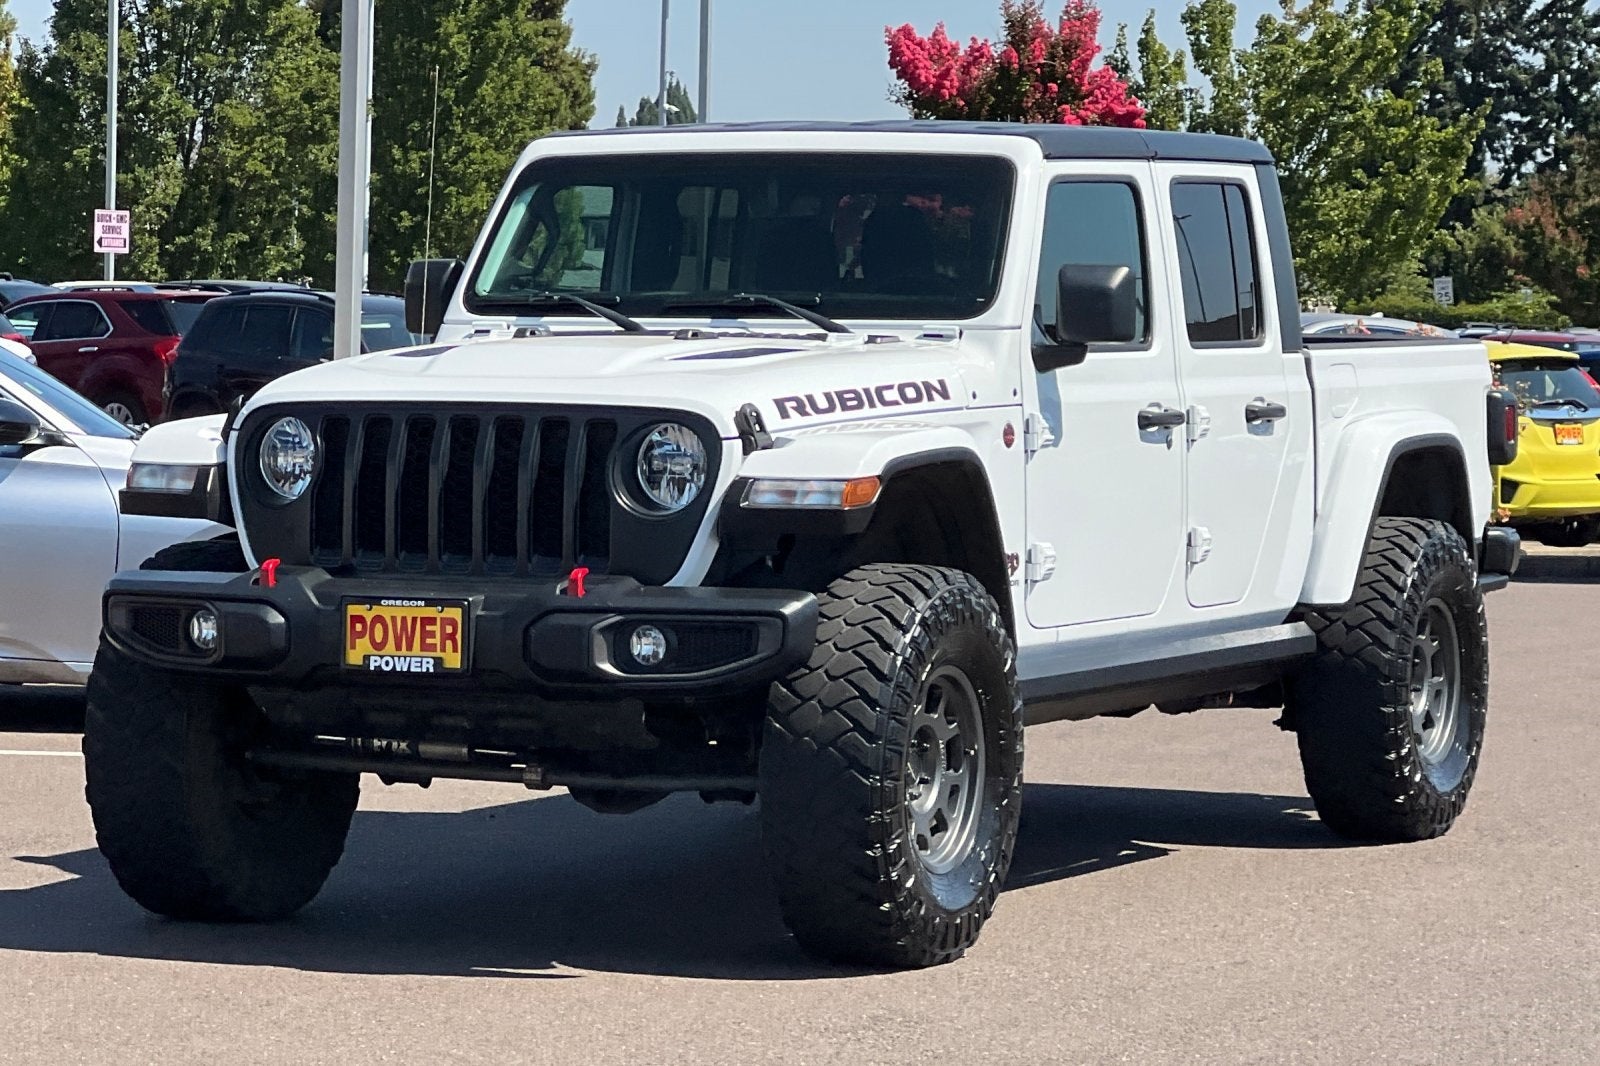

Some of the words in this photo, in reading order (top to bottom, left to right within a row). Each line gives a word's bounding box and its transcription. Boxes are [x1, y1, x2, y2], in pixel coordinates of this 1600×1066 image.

[97, 213, 112, 223] BUICK
[116, 214, 127, 223] GMC
[102, 225, 122, 235] SERVICE
[1438, 292, 1451, 302] 25
[772, 379, 951, 420] RUBICON
[1556, 427, 1582, 438] POWER
[380, 599, 425, 607] OREGON
[349, 614, 459, 653] POWER
[369, 655, 434, 673] POWER
